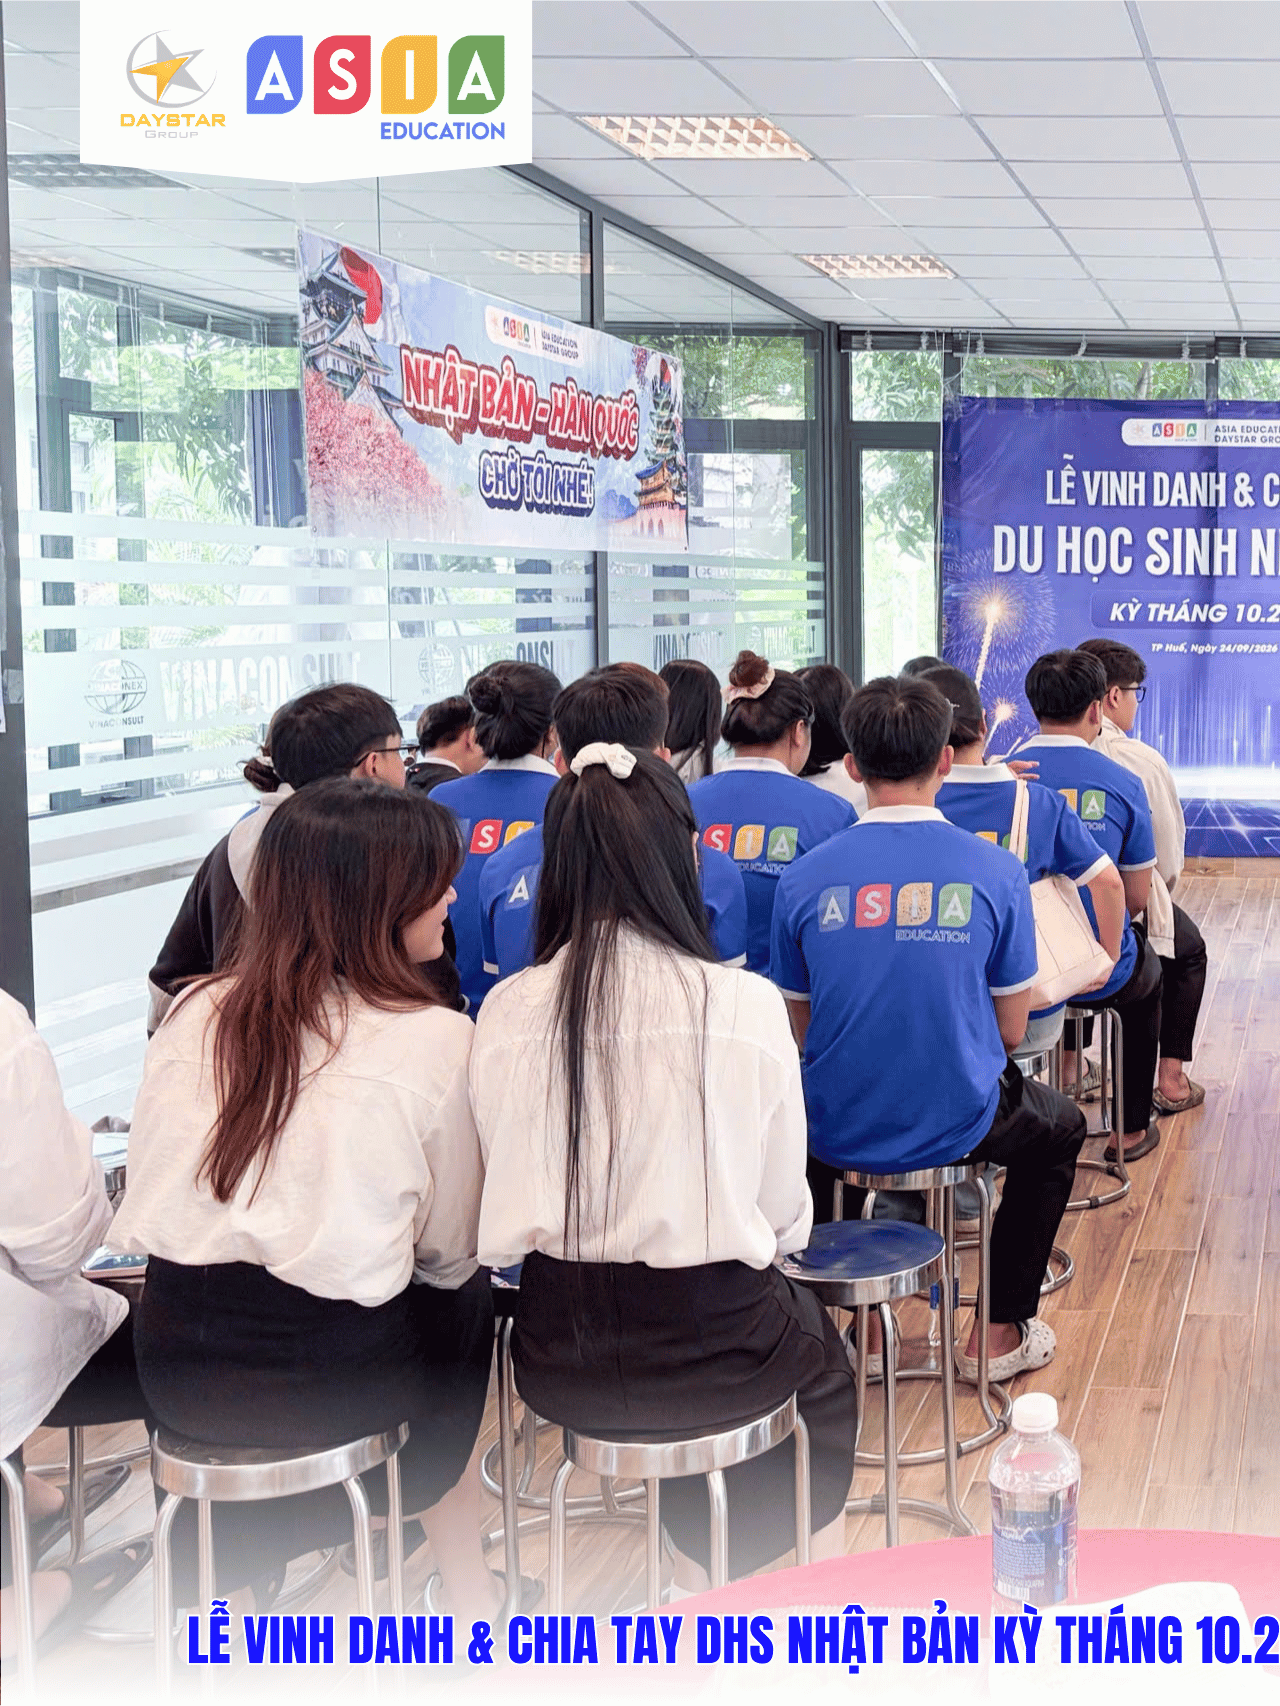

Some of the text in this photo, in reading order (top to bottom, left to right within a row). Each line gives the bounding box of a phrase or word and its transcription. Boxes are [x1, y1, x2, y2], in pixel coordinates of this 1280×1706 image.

[401, 349, 478, 432] NHẬT
[479, 358, 535, 432] BẢN
[550, 381, 593, 443] HÀN
[593, 391, 639, 451] QUỐC
[1152, 422, 1197, 437] ASIA
[1214, 425, 1237, 434] ASIA
[1214, 435, 1257, 443] DAYSTAR
[481, 449, 595, 509] CHỜ TÔI NHÉ!
[1046, 453, 1076, 505] LỄ
[1082, 470, 1146, 507] VINH
[1153, 471, 1226, 507] DANH
[1233, 472, 1255, 508] &
[993, 525, 1044, 574] DU
[1057, 525, 1133, 584] HỌC
[1145, 527, 1237, 576] SINH
[1109, 597, 1142, 622] KỲ
[1147, 598, 1228, 623] THÁNG
[1151, 642, 1163, 653] TP
[1190, 643, 1218, 655] Ngày
[1219, 643, 1279, 654] 24/09/2026
[709, 828, 791, 857] SIA
[821, 890, 966, 925] ASIA
[895, 929, 971, 944] EDUCATION
